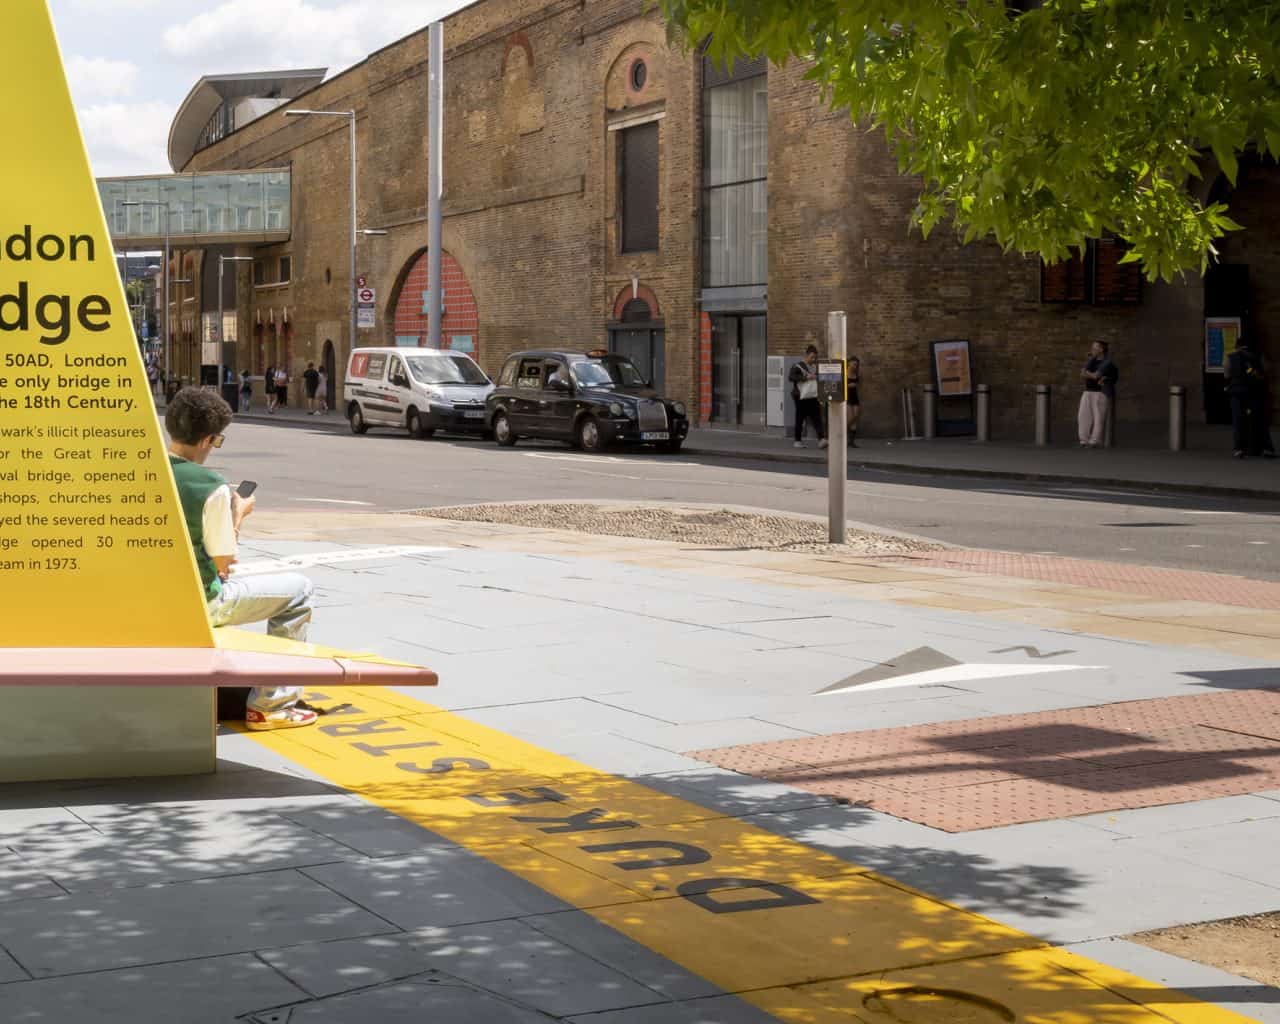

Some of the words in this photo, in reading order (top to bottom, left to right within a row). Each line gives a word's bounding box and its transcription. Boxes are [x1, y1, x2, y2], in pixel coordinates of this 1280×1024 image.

[5, 353, 53, 369] 50AD,
[64, 353, 127, 368] London
[14, 374, 51, 392] only
[57, 374, 111, 392] bridge
[117, 374, 133, 388] in
[24, 392, 61, 409] 18th
[66, 394, 138, 413] Century.
[47, 426, 78, 438] illicit
[82, 426, 146, 440] pleasures
[21, 447, 43, 460] the
[53, 447, 92, 460] Great
[102, 447, 127, 460] Fire
[137, 447, 152, 460] of
[27, 470, 74, 485] bridge,
[83, 470, 136, 484] opened
[144, 469, 158, 482] in
[48, 491, 112, 504] churches
[120, 491, 146, 505] and
[154, 494, 163, 504] a
[25, 513, 49, 526] the
[52, 511, 106, 528] severed
[109, 513, 151, 527] heads
[153, 513, 169, 526] of
[31, 535, 83, 551] opened
[96, 535, 114, 548] 30
[126, 536, 174, 548] metres
[28, 557, 41, 570] in
[44, 557, 81, 570] 1973.
[988, 645, 1078, 659] N
[462, 787, 823, 915] DUKE
